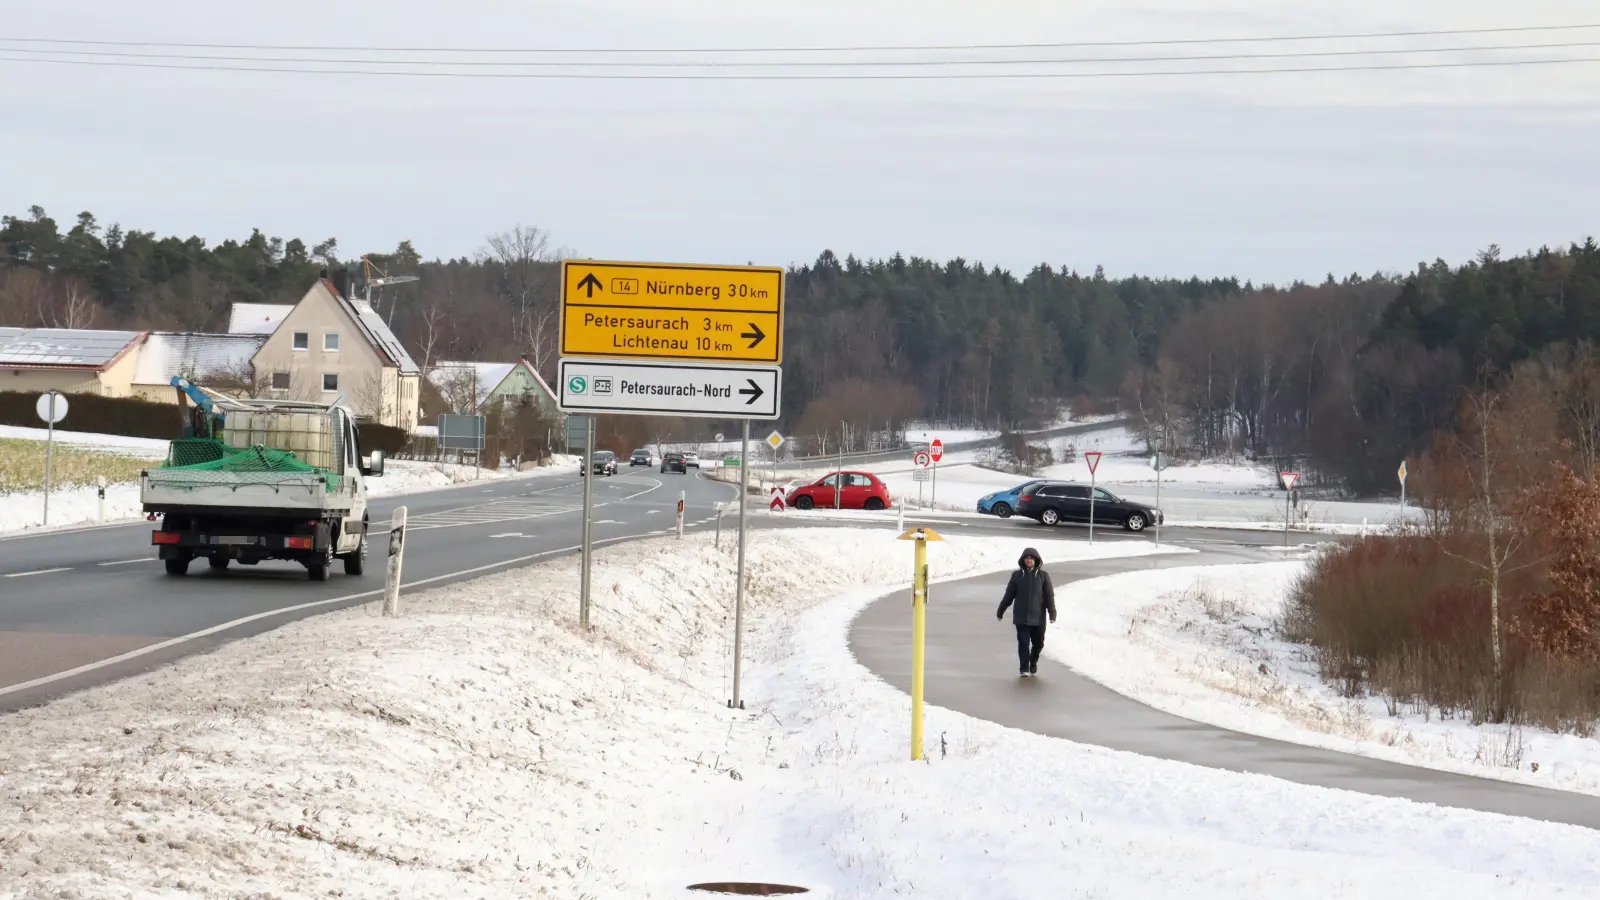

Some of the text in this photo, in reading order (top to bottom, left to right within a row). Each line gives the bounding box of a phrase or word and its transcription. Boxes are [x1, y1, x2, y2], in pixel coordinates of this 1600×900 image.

[618, 281, 768, 300] 14 Nürnberg 30 km
[584, 313, 733, 332] Petersaurach 3 km
[613, 334, 733, 352] Lichtenau 10 km
[620, 380, 731, 398] Petersaurach-Nord
